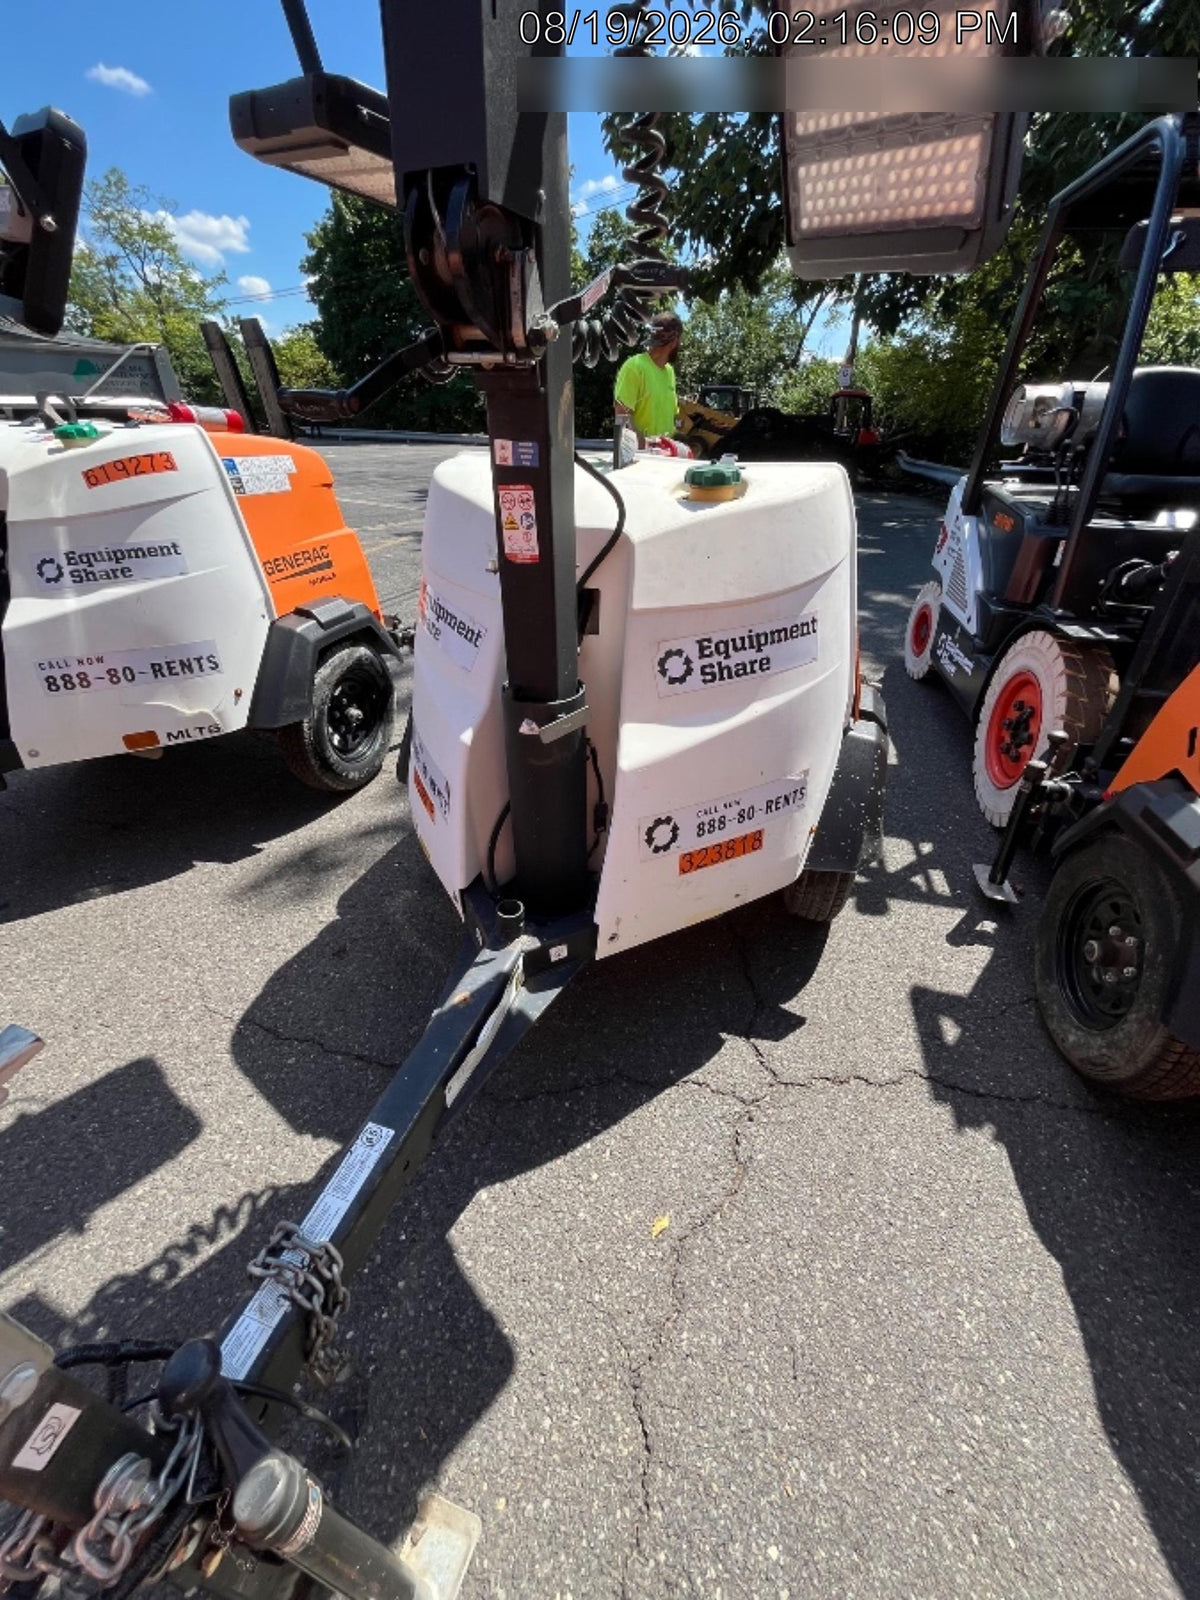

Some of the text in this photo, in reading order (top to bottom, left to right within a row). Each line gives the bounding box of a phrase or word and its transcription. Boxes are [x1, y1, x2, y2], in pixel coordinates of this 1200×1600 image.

[84, 452, 175, 487] 619273
[64, 542, 182, 567] Equipment
[262, 544, 330, 576] GENERAC
[69, 566, 134, 583] Share
[696, 616, 818, 660] Equipment
[38, 655, 104, 671] CALL NOW
[44, 654, 220, 692] 888-80-RENTS
[700, 656, 771, 684] Share
[696, 805, 719, 818] CALL
[696, 786, 807, 838] 888-80-RENTS
[681, 830, 764, 873] 323818
